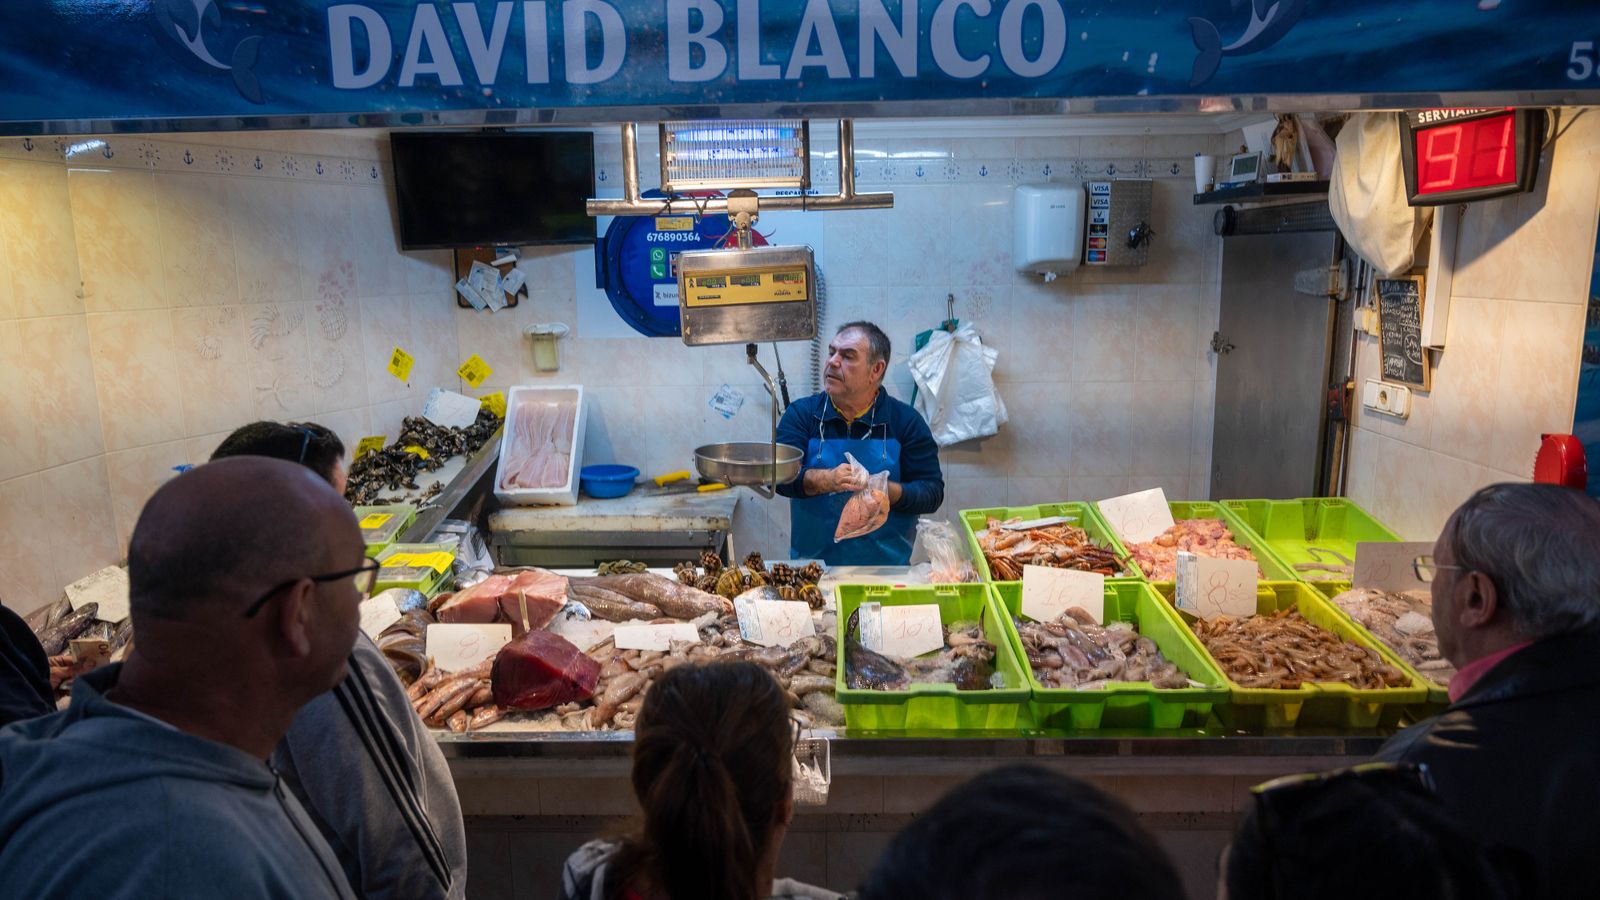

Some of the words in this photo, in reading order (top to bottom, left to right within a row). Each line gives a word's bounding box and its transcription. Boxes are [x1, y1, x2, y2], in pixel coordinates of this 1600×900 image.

[327, 0, 627, 89] DAVID
[667, 0, 1067, 82] BLANCO
[1566, 41, 1600, 81] 5
[1422, 117, 1512, 190] 91
[646, 232, 700, 242] 676890364
